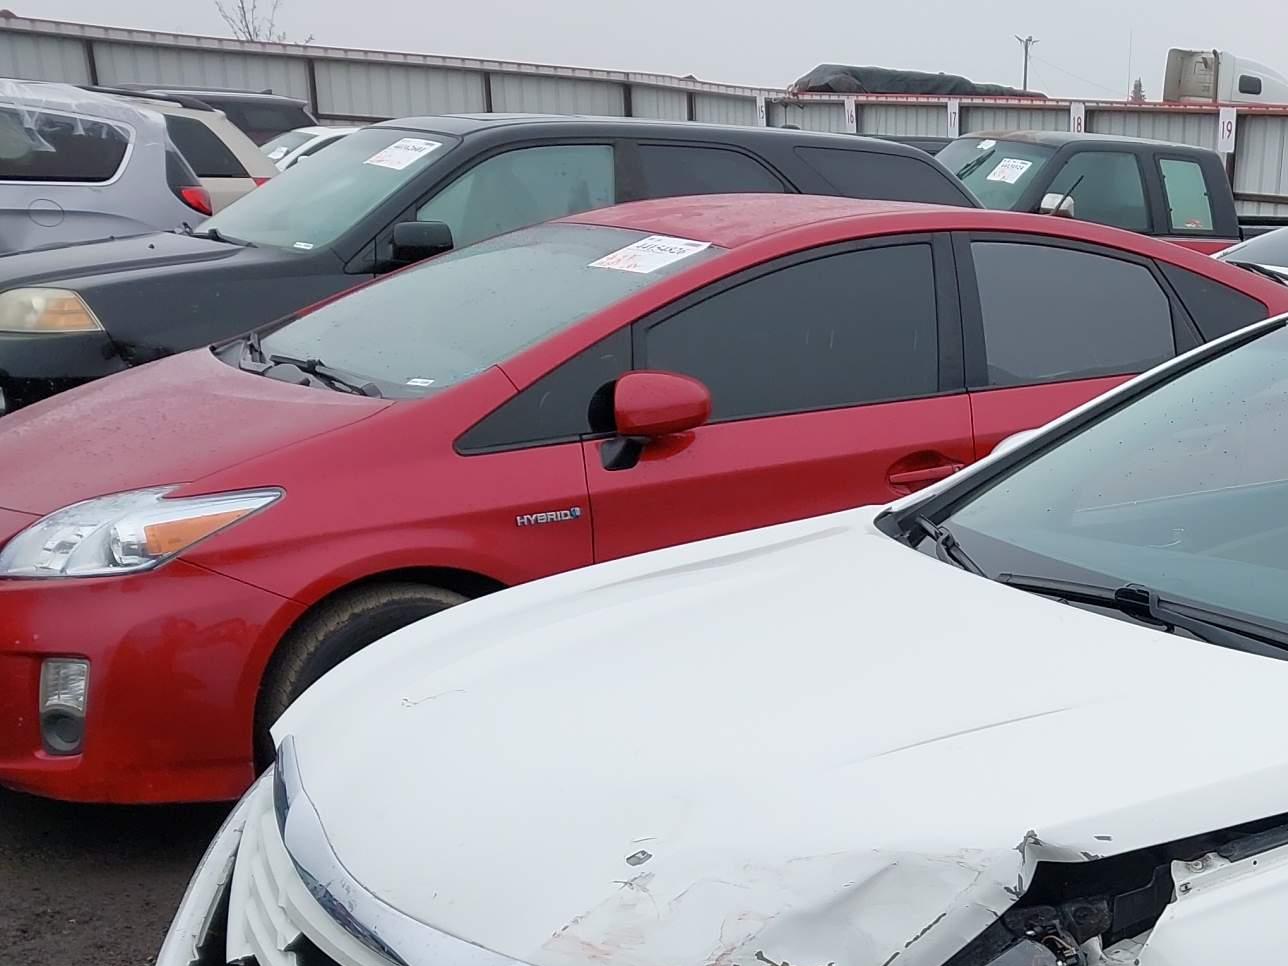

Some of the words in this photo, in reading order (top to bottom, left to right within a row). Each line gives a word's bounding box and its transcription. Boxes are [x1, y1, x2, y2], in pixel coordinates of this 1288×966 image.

[847, 109, 855, 124] 16
[950, 111, 957, 128] 17
[1072, 116, 1082, 133] 18
[1221, 121, 1233, 140] 19
[516, 510, 571, 526] HYBRID
